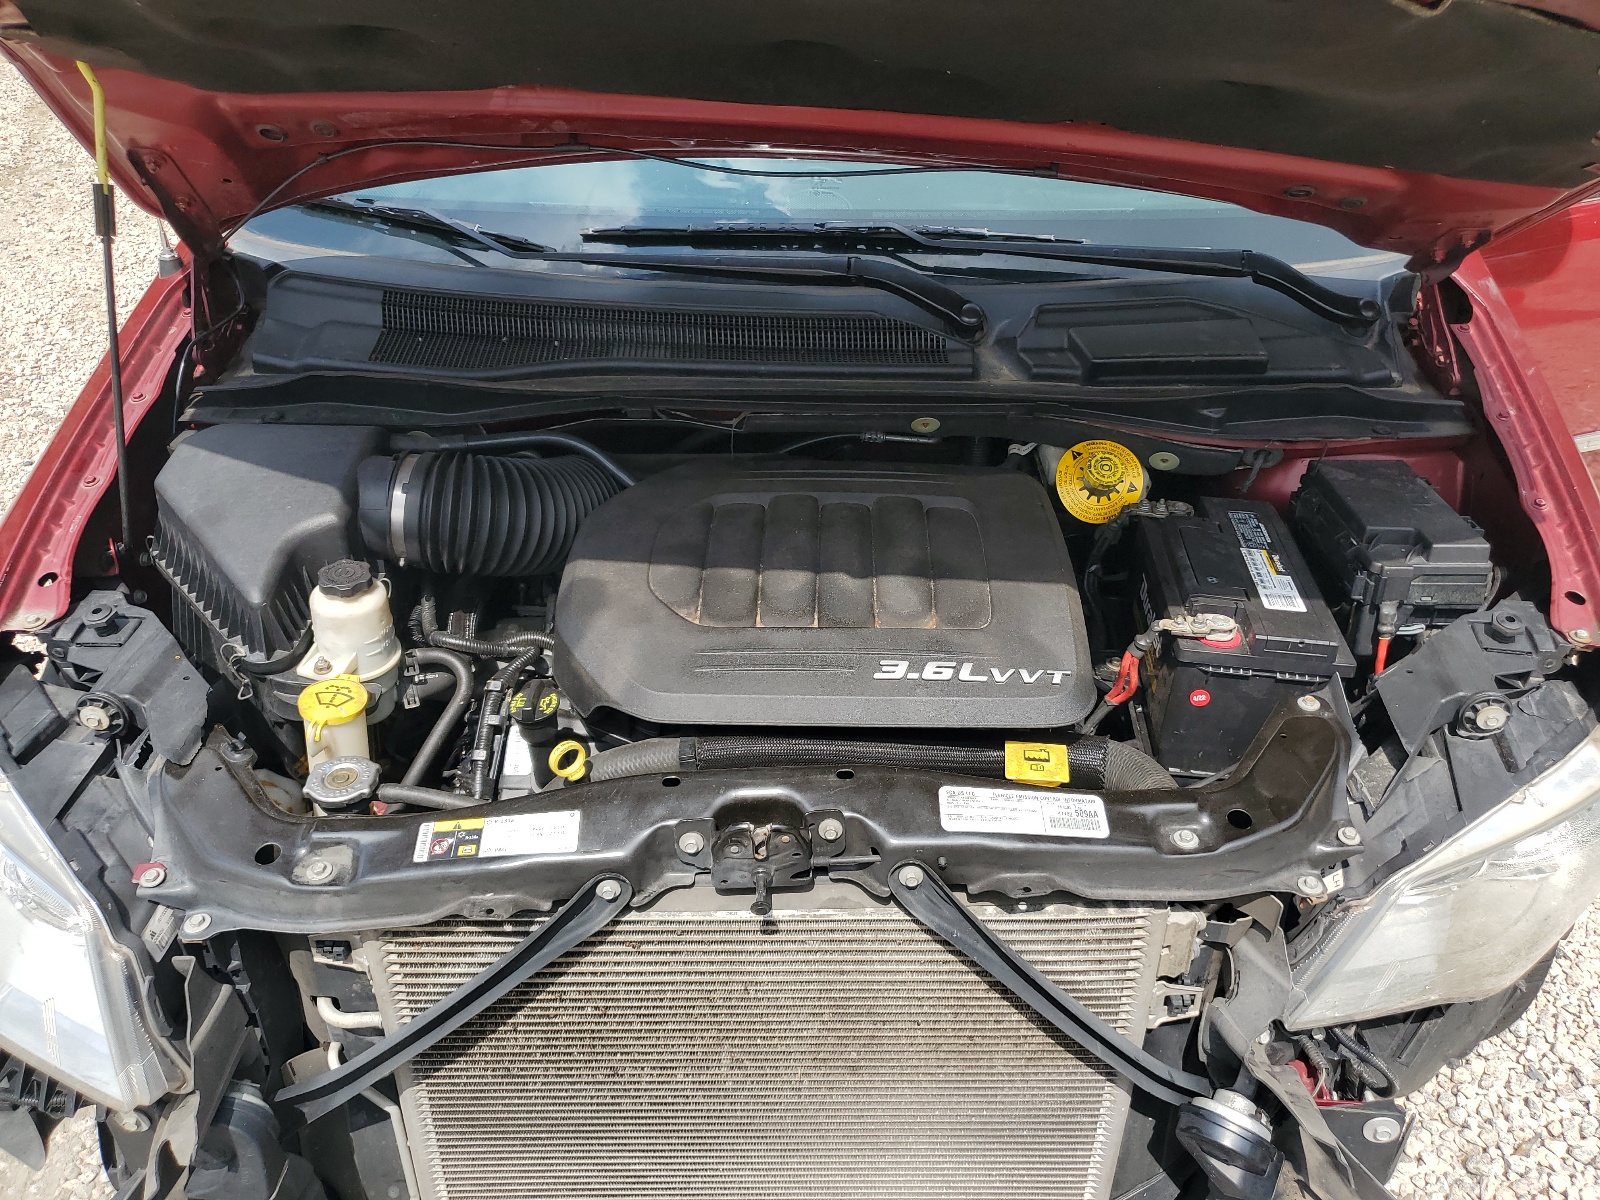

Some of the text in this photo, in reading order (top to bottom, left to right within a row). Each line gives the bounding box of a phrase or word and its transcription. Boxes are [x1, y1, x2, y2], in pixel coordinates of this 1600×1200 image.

[989, 667, 1071, 685] VVT
[1192, 694, 1206, 702] 4/22
[1074, 809, 1099, 819] 509AA
